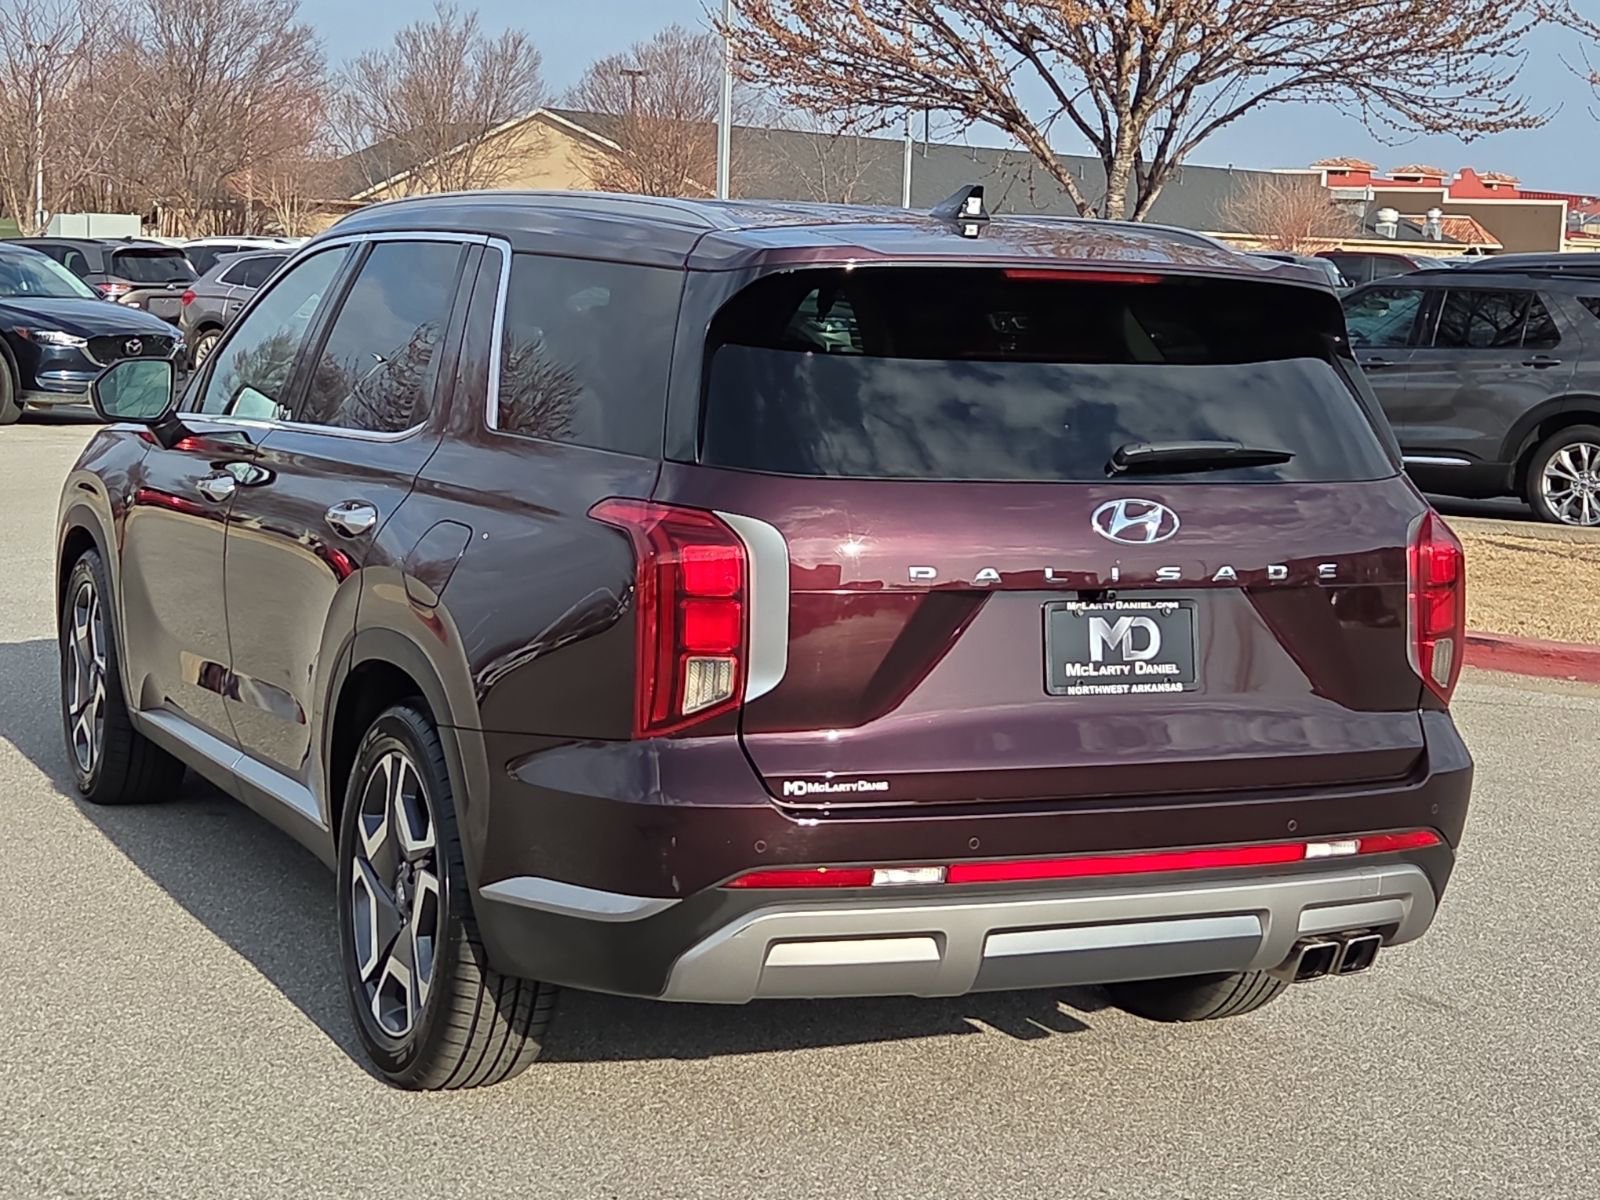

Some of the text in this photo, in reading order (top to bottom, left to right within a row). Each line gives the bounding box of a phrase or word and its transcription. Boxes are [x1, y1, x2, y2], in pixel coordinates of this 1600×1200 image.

[908, 563, 1337, 584] PALISADE
[1089, 616, 1161, 662] MD
[1134, 661, 1180, 675] DANIEL
[1067, 682, 1183, 695] NORTHWEST ARKANSAS
